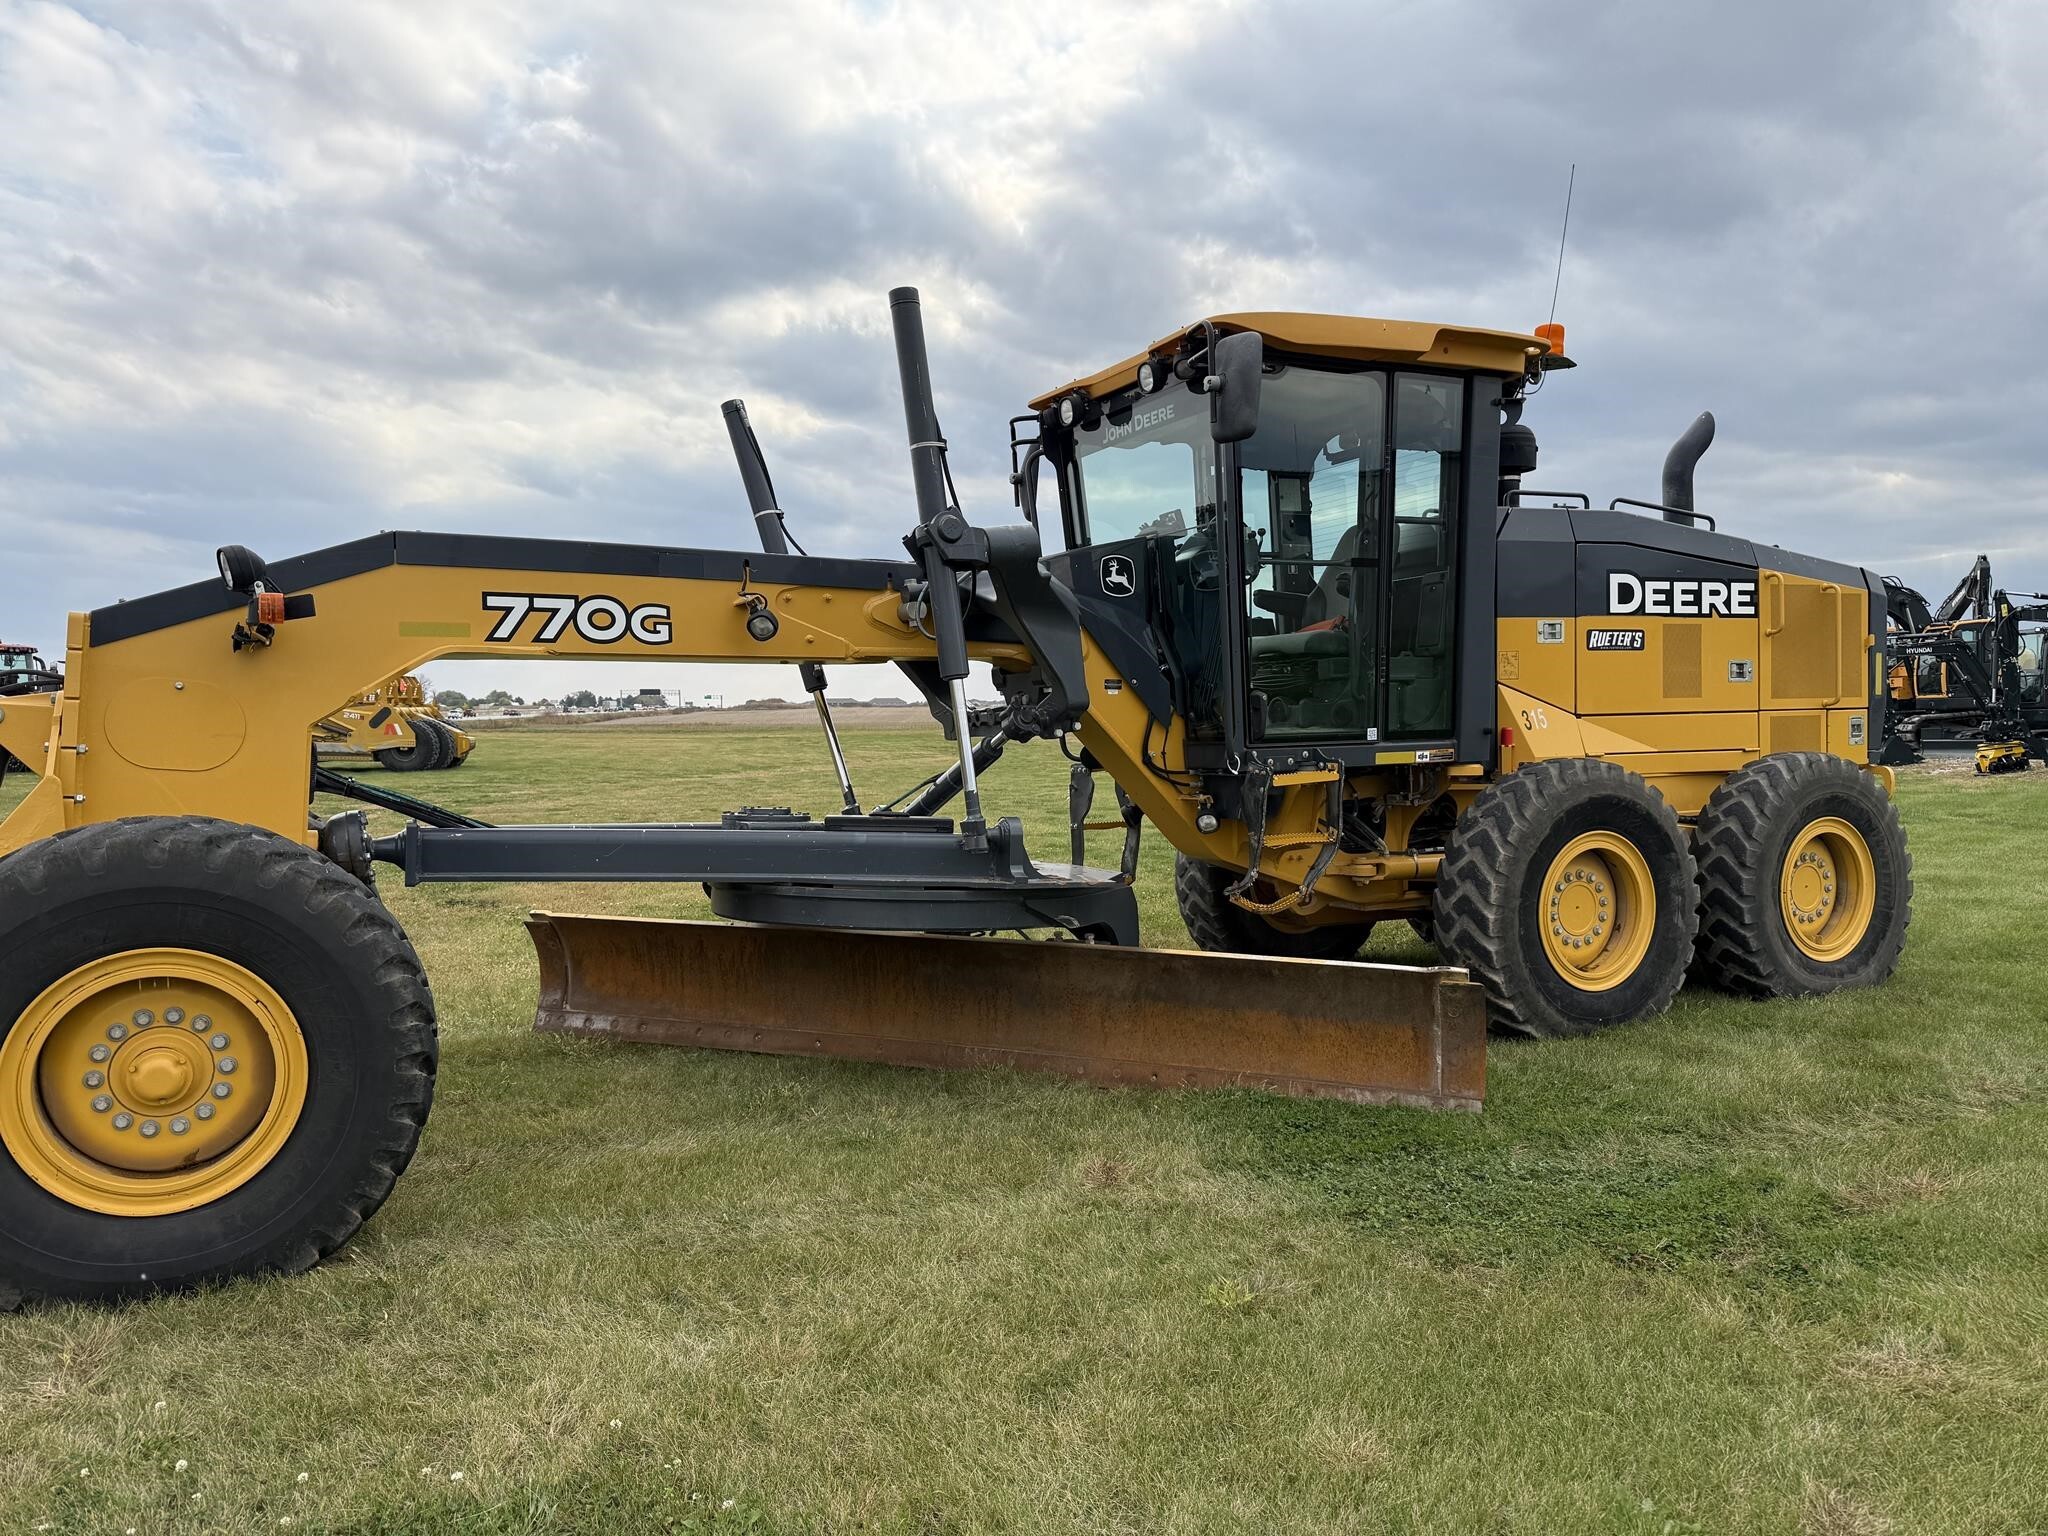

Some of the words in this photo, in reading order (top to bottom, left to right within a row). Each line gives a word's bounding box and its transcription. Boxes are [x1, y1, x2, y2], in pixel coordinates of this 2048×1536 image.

[1134, 404, 1175, 431] DEERE
[1609, 573, 1755, 615] DEERE
[484, 594, 672, 644] 770G
[1589, 630, 1643, 648] RUETER'S
[1521, 708, 1548, 731] 315
